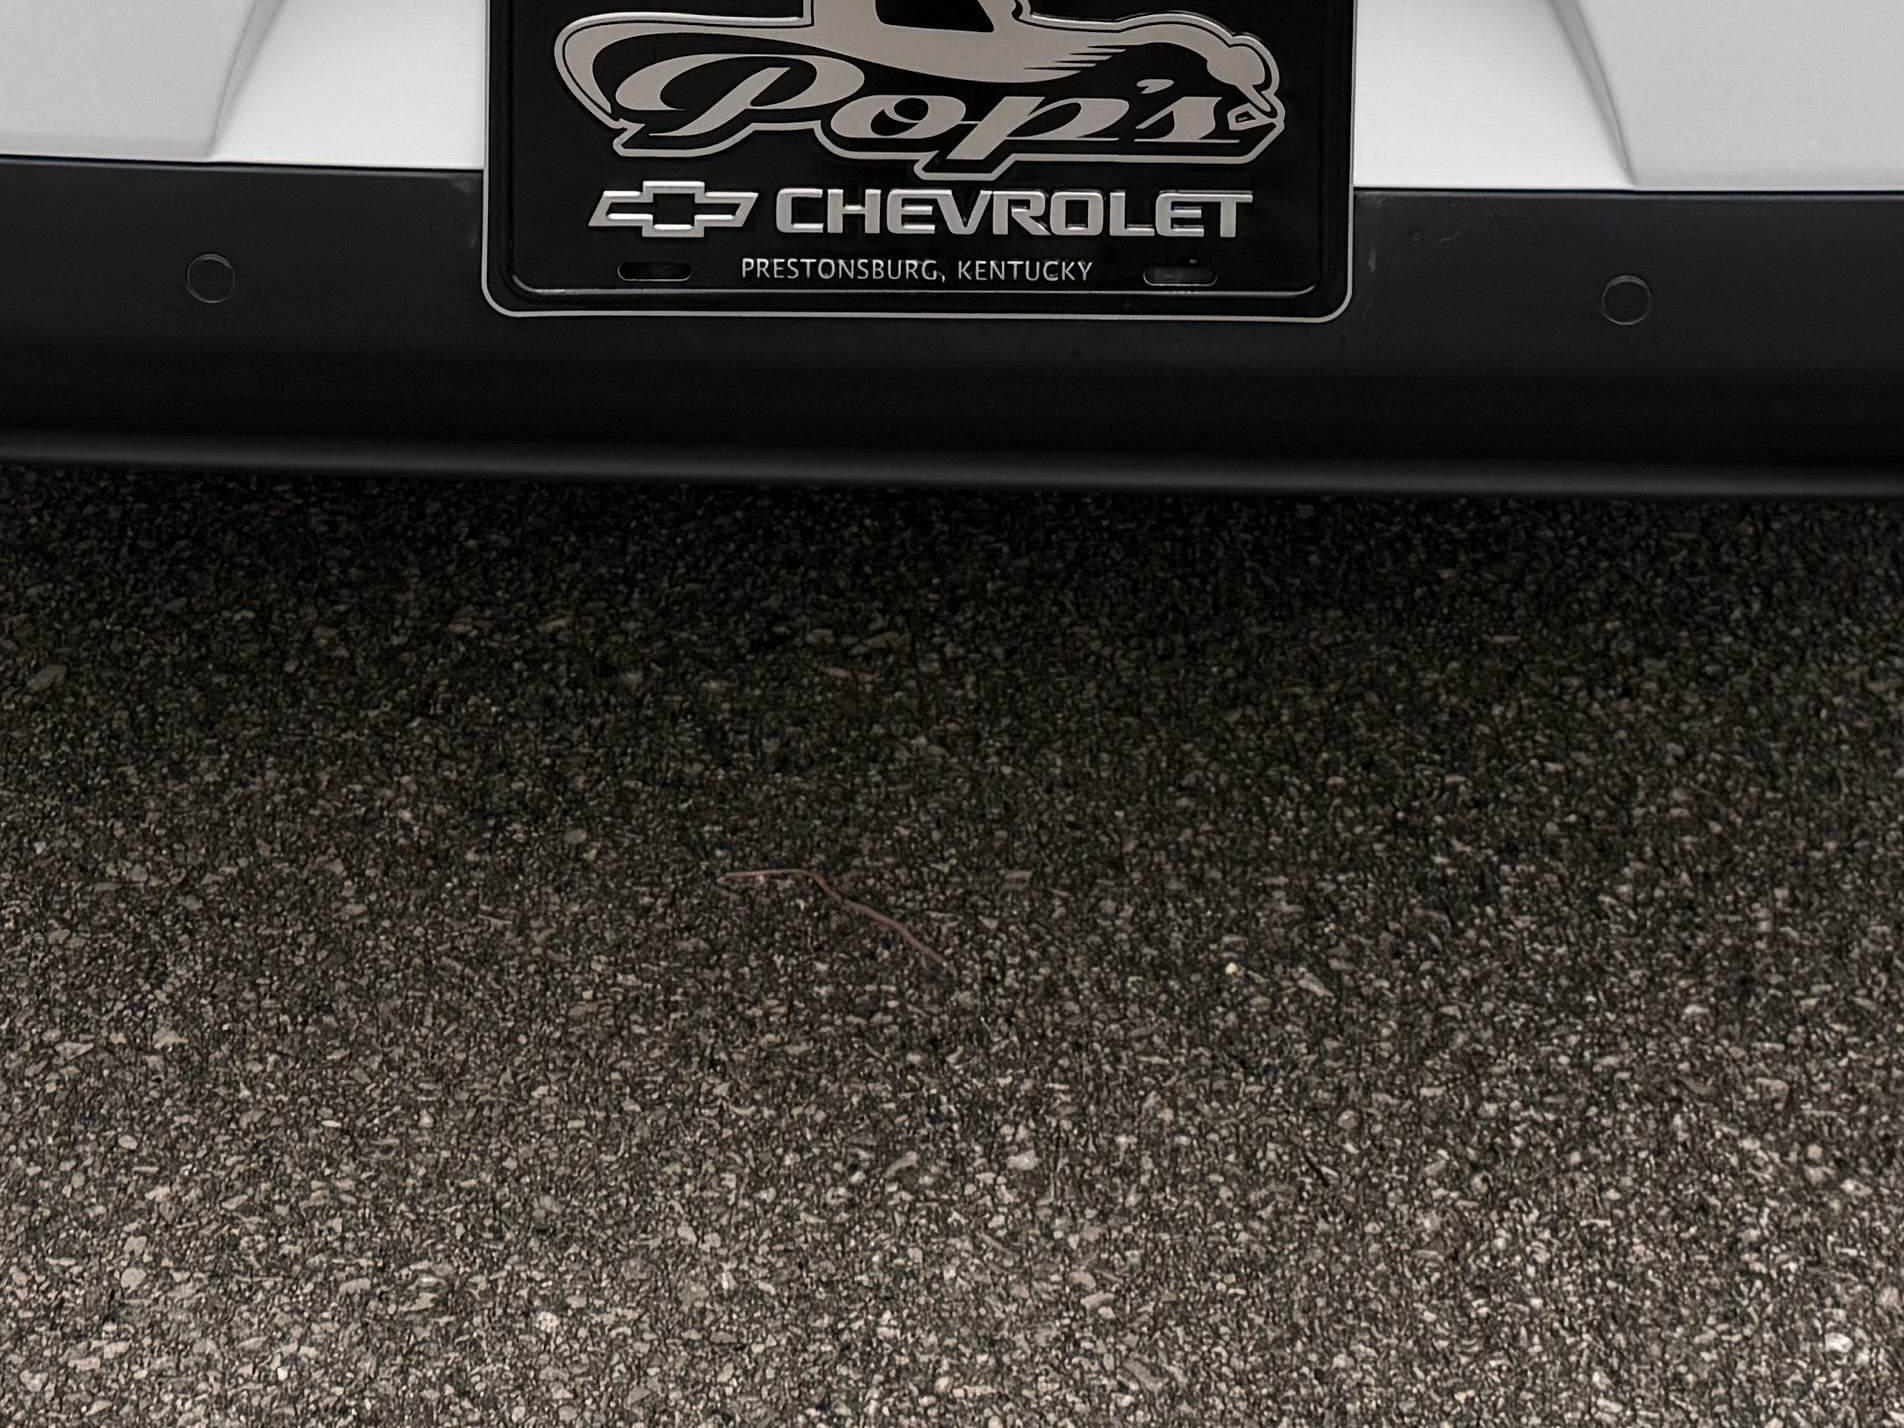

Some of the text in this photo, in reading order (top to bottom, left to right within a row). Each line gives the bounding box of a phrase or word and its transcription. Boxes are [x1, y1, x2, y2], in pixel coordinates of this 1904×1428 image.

[614, 52, 1240, 162] Pop's
[775, 186, 1254, 239] CHEVROLET
[740, 257, 1094, 283] PRESTONSBURG, KENTUCKY
